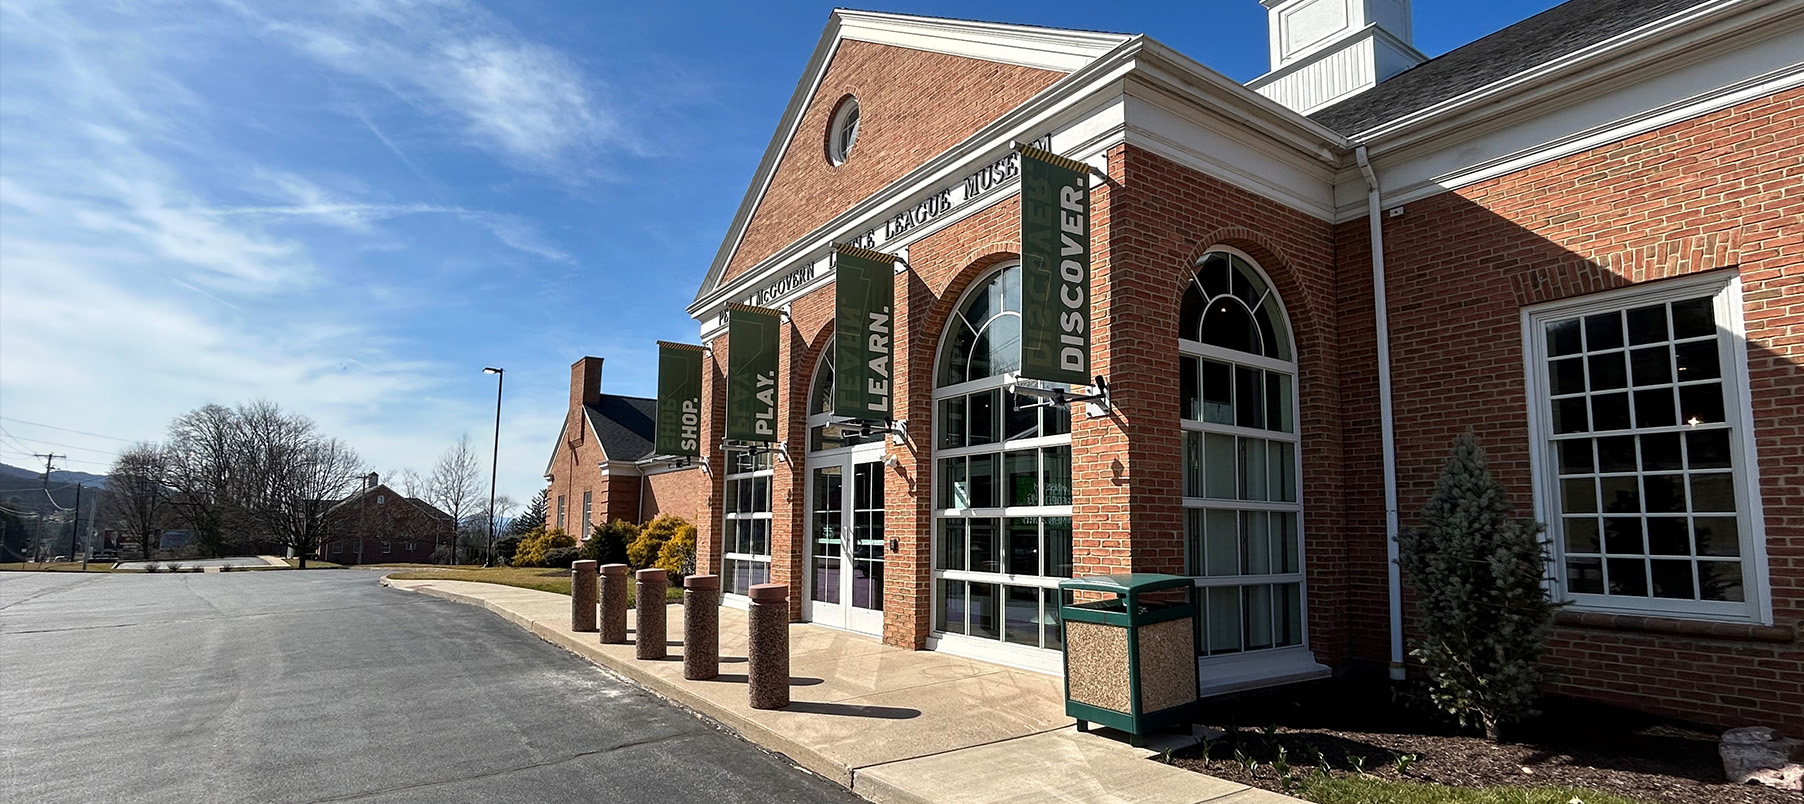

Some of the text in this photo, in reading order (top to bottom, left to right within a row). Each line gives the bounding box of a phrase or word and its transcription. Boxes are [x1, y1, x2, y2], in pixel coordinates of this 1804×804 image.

[884, 188, 952, 241] LEAGUE
[963, 132, 1053, 201] MUSEM
[1060, 177, 1084, 373] DISCOVER.
[755, 370, 775, 435] PLAY.
[868, 305, 890, 412] LEARN.
[681, 397, 699, 451] SHOP.
